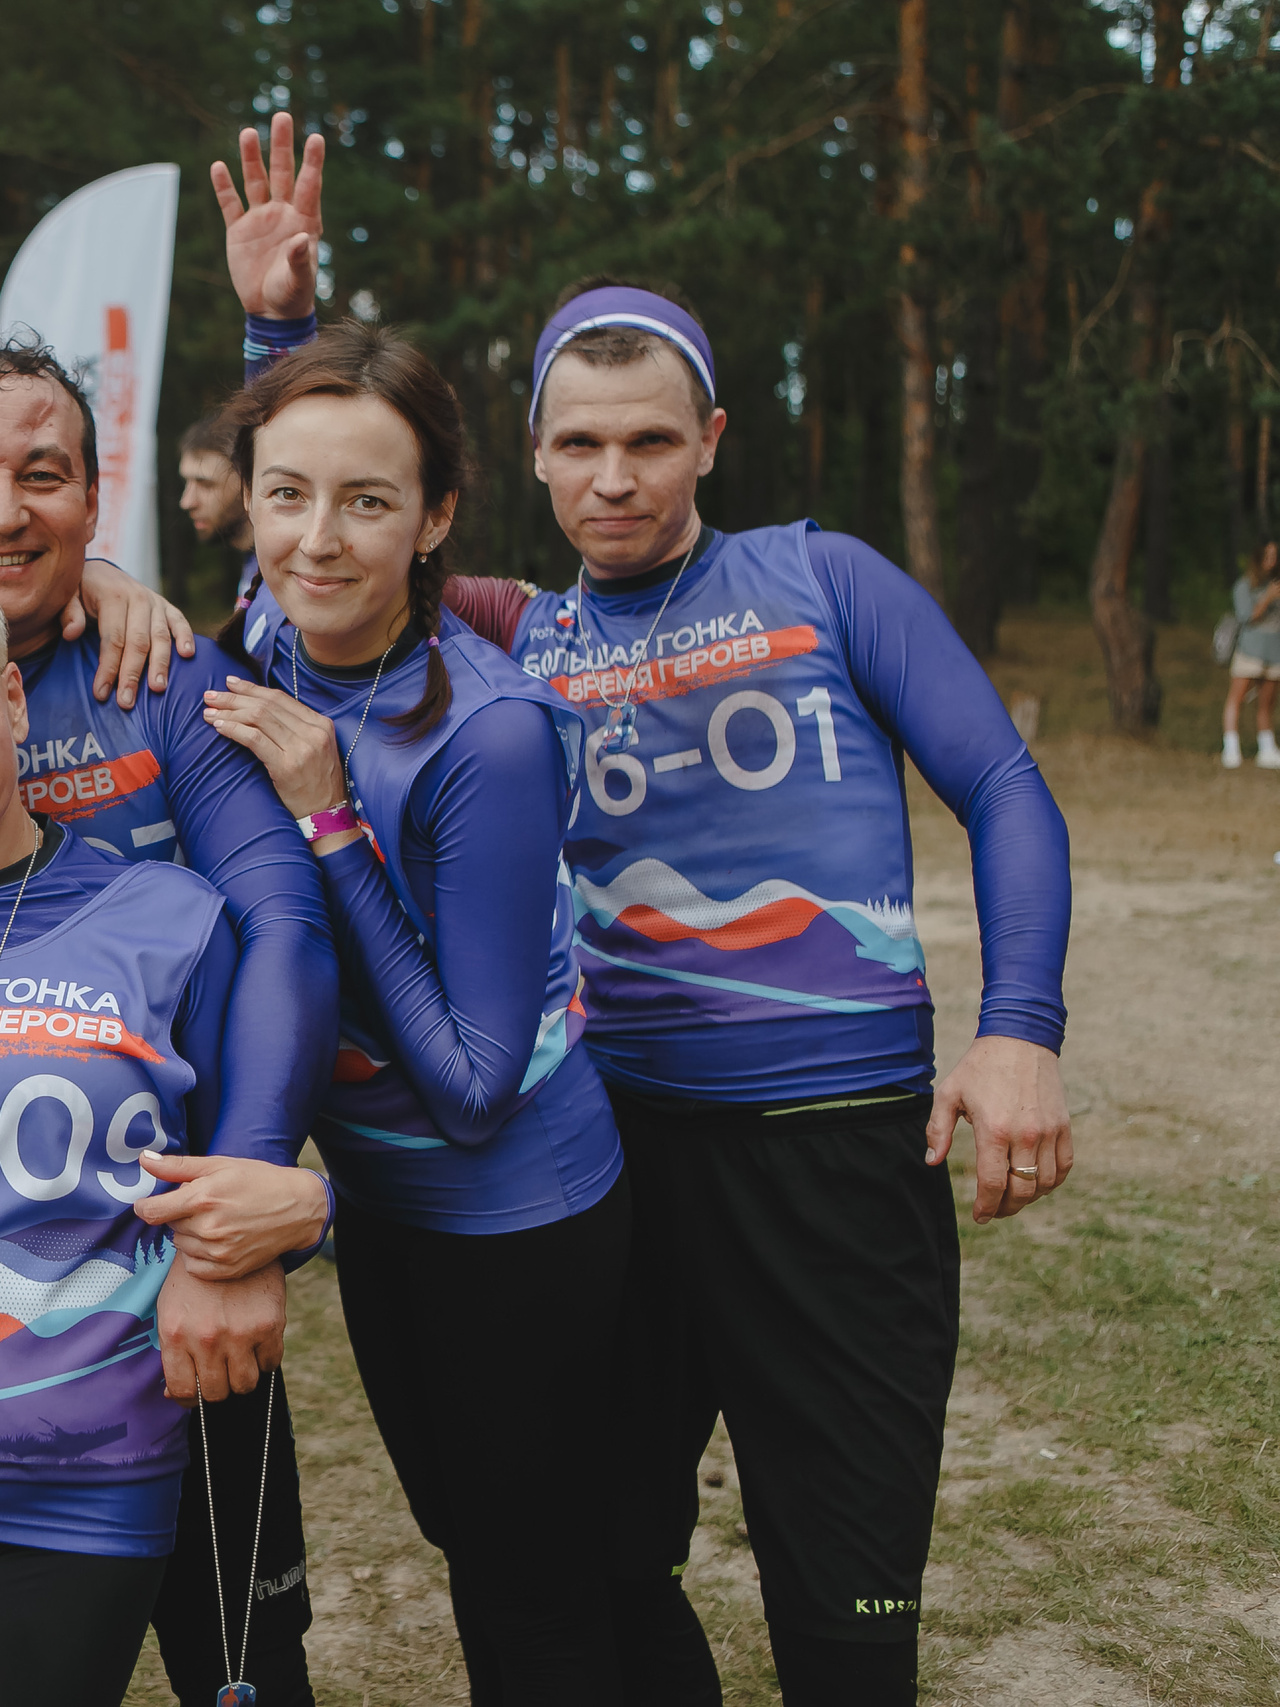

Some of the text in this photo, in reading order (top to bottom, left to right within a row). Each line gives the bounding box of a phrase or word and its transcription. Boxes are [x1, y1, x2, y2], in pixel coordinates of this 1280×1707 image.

[522, 608, 764, 677] БОЛЬШАЯ ГОНКА
[567, 635, 771, 701] ВРЕМЯ ГЕРОЕВ
[568, 686, 842, 830] 6-01
